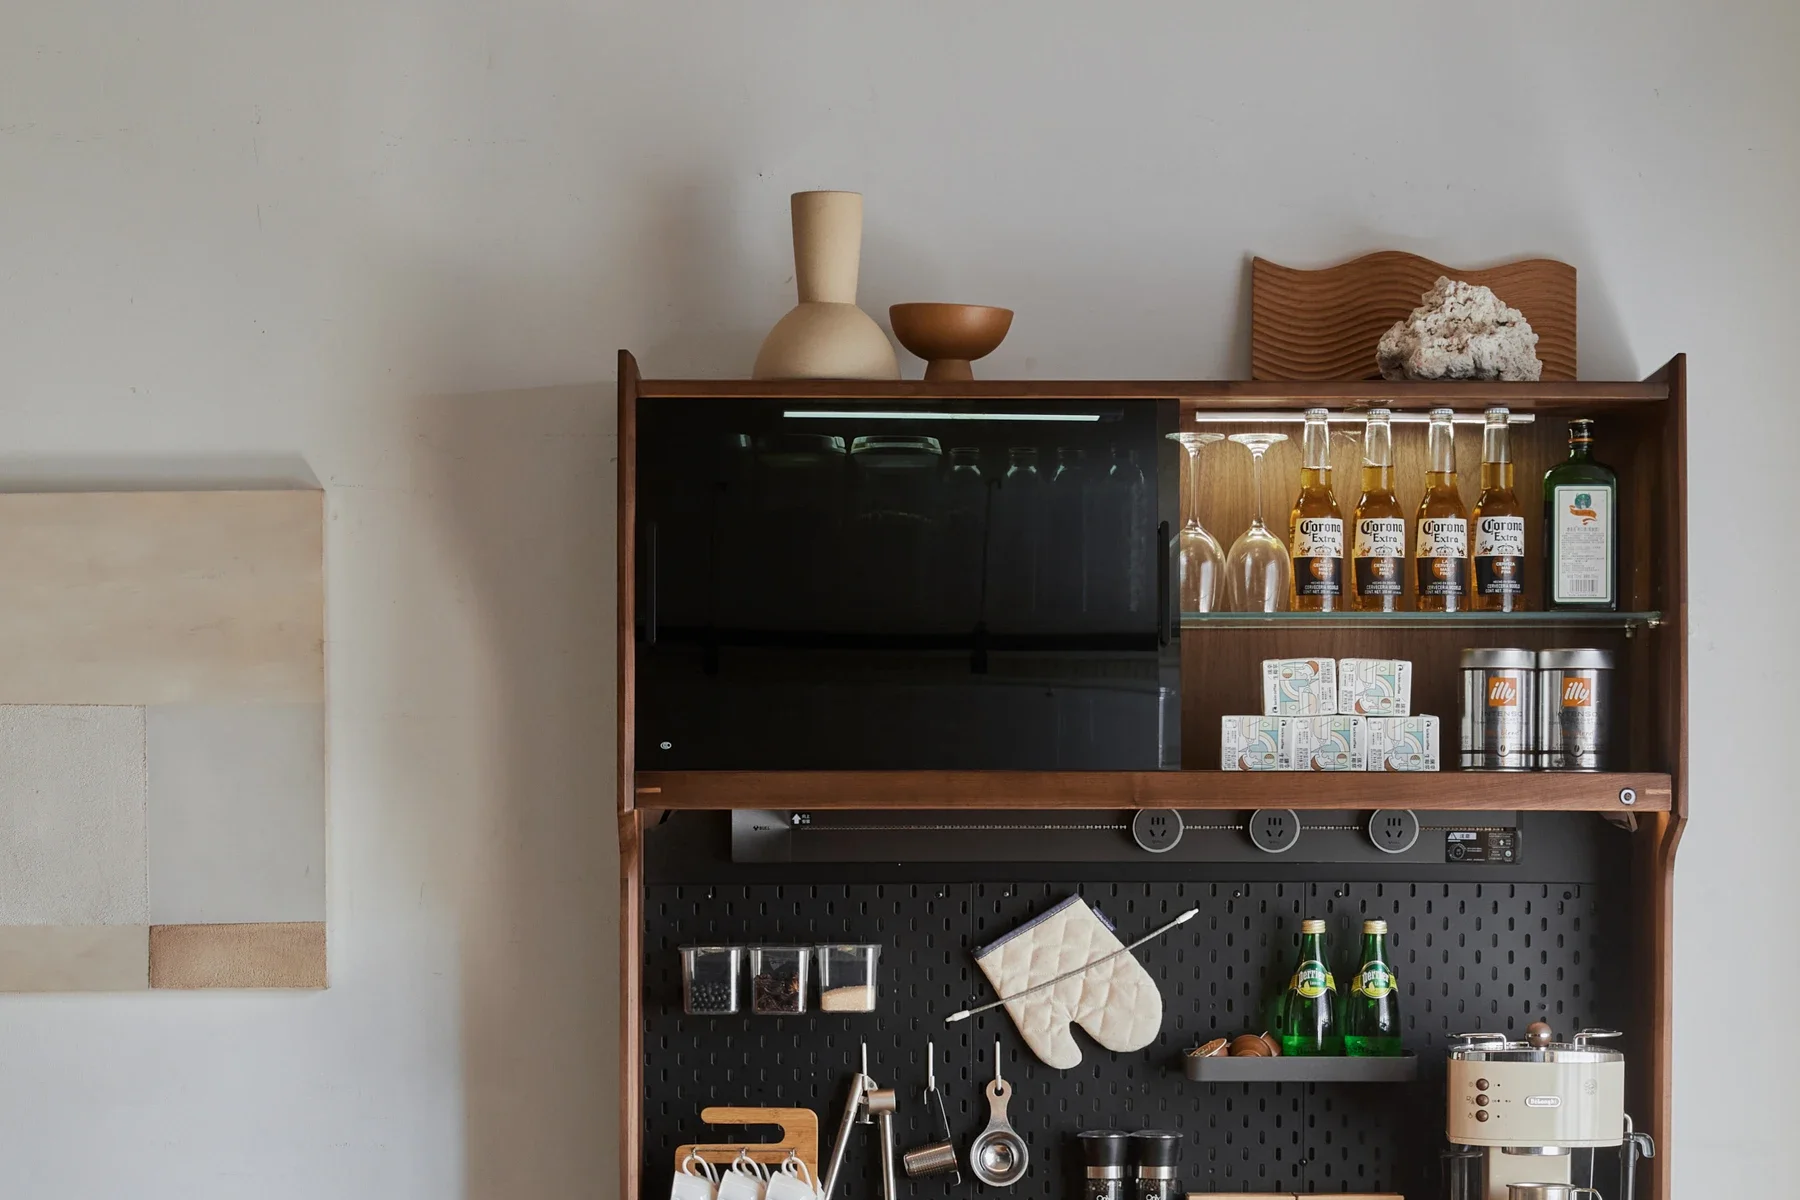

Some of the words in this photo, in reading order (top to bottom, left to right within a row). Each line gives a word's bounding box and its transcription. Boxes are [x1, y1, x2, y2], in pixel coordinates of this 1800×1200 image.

[1300, 520, 1342, 536] Corona
[1361, 520, 1403, 536] Corona
[1423, 520, 1465, 536] Corona
[1482, 519, 1523, 535] Corona
[1312, 533, 1336, 542] Extra
[1373, 533, 1397, 542] Extra
[1434, 533, 1458, 542] Extra
[1494, 532, 1517, 541] Extra
[1490, 682, 1516, 704] illy
[1564, 682, 1590, 704] illy
